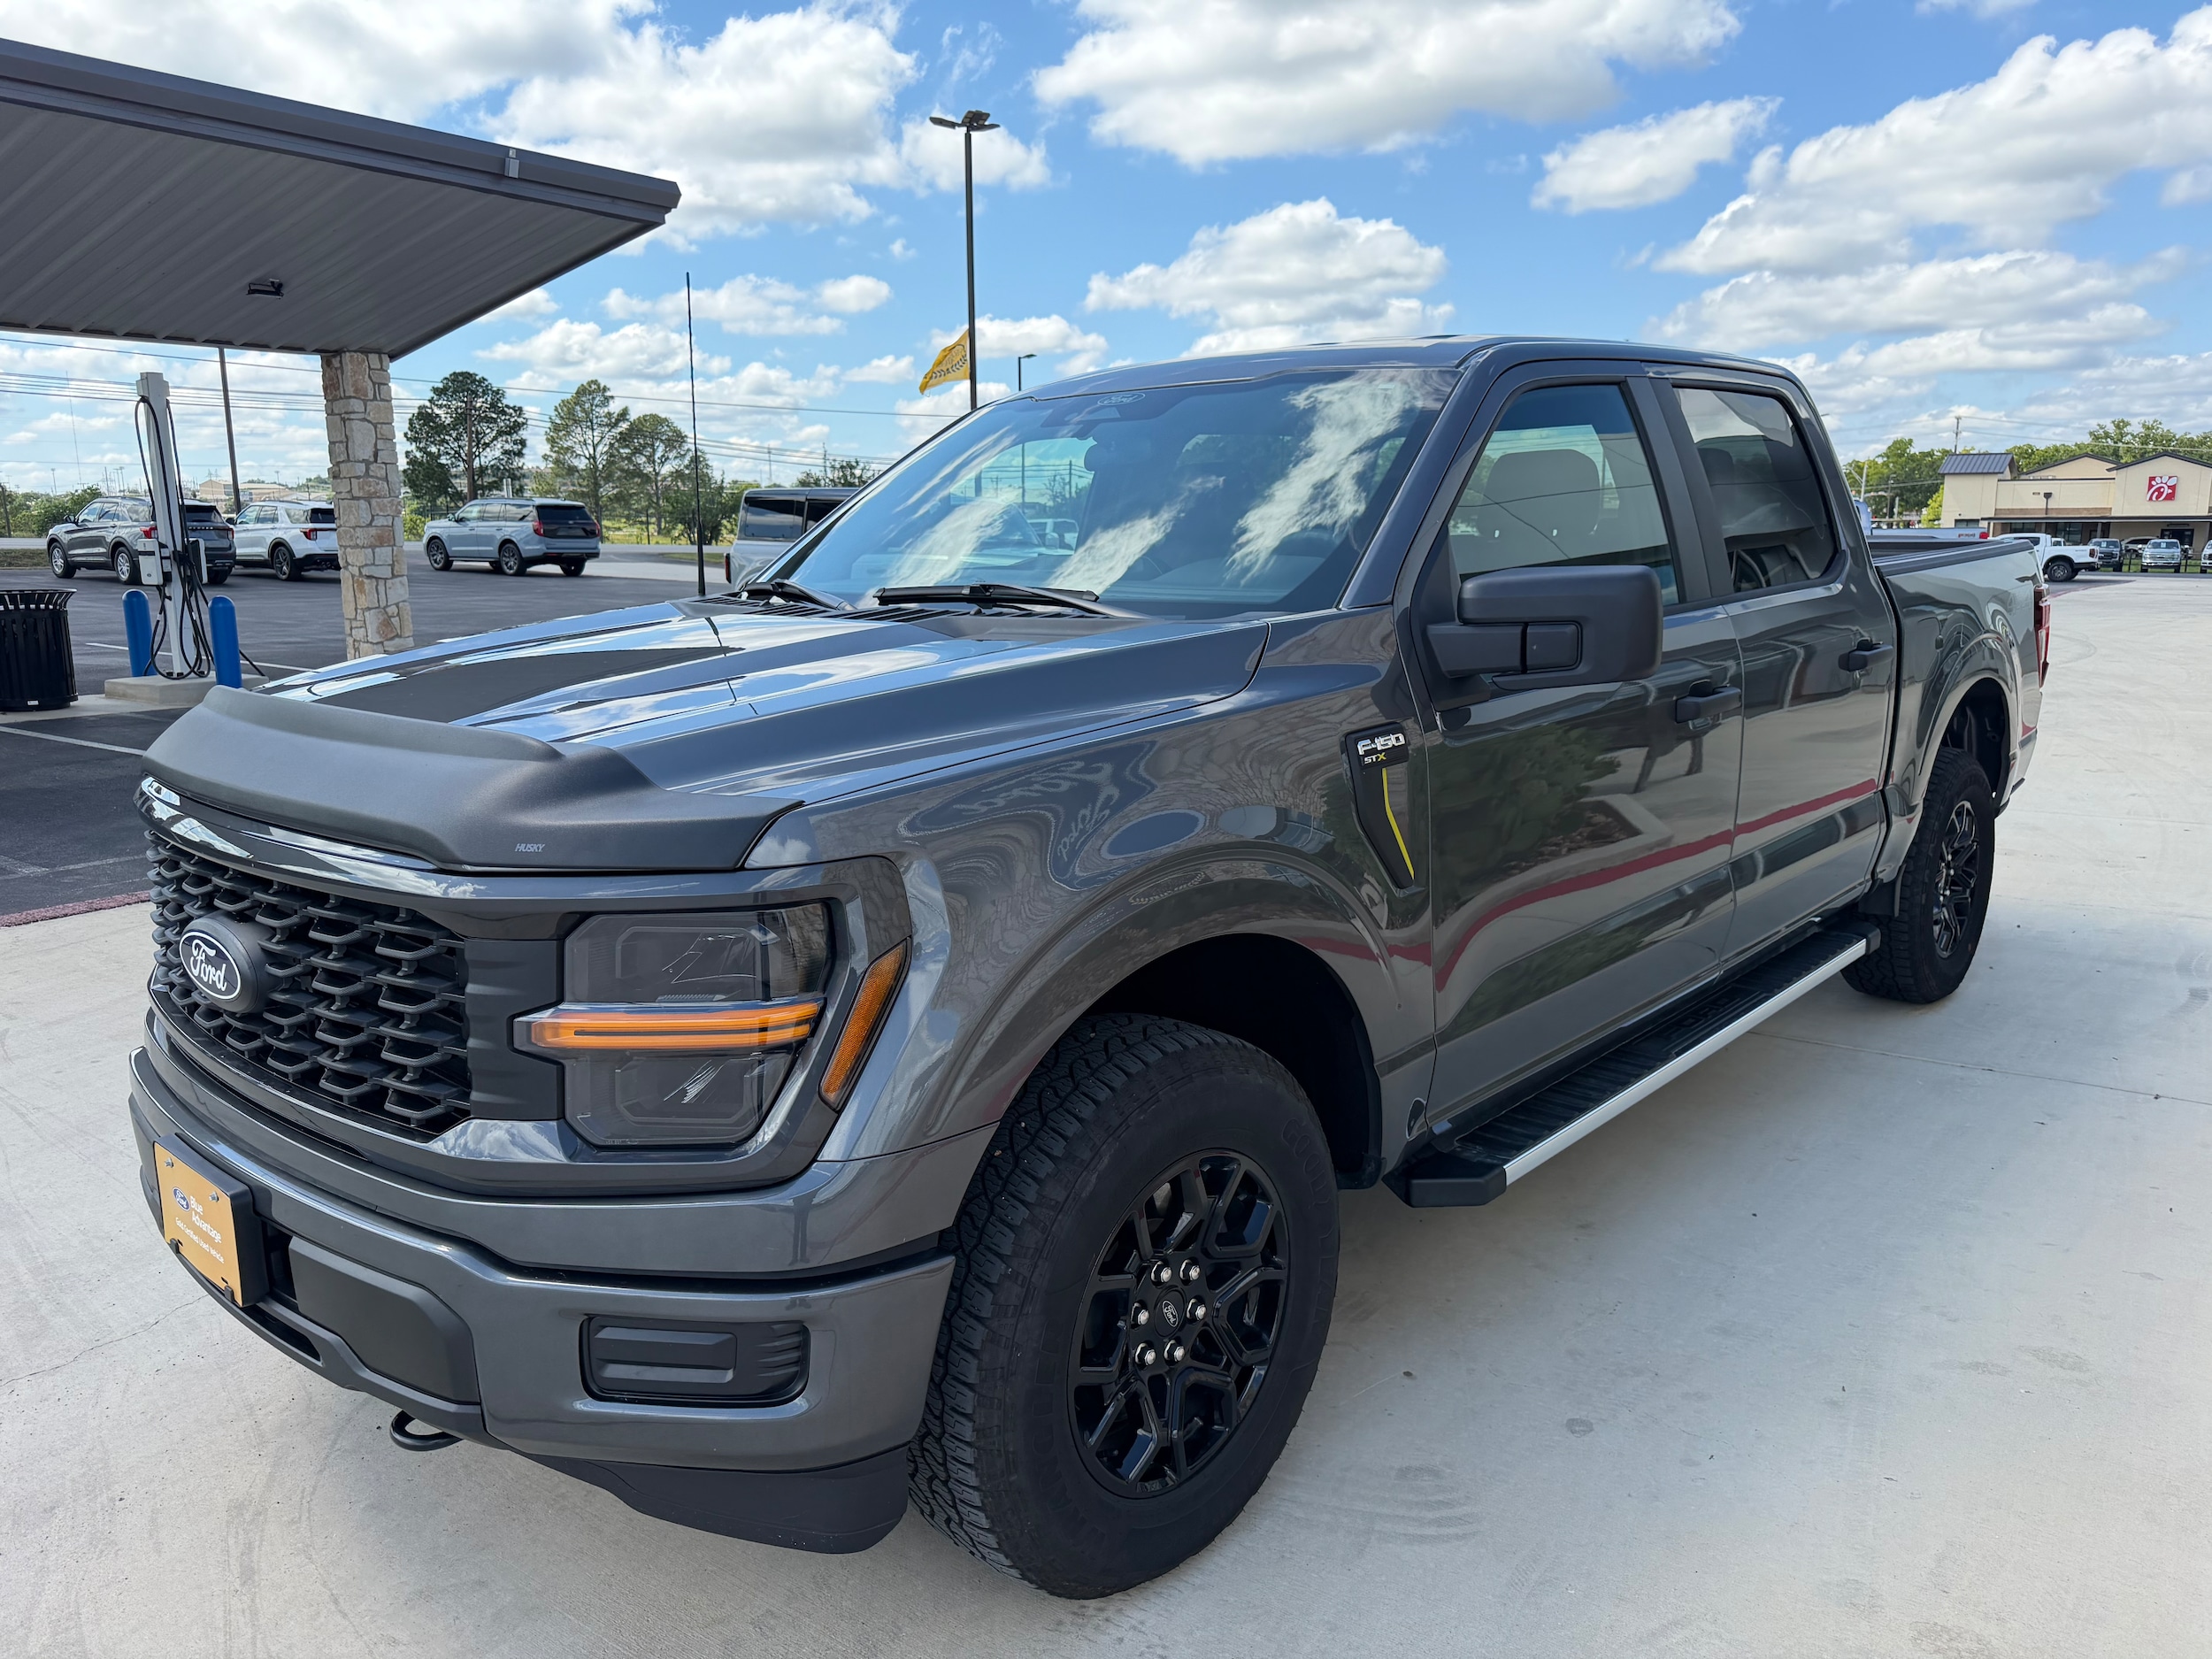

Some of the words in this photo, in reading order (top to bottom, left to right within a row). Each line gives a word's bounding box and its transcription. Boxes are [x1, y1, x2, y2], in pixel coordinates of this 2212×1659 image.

[1357, 733, 1405, 755] F-150
[1364, 752, 1386, 764] STX
[515, 843, 545, 852] HUSKY
[190, 939, 227, 991] Ford
[189, 1195, 204, 1216] Blue
[191, 1210, 222, 1244] Advantage
[198, 1237, 210, 1252] Used
[209, 1246, 225, 1264] Vehicle
